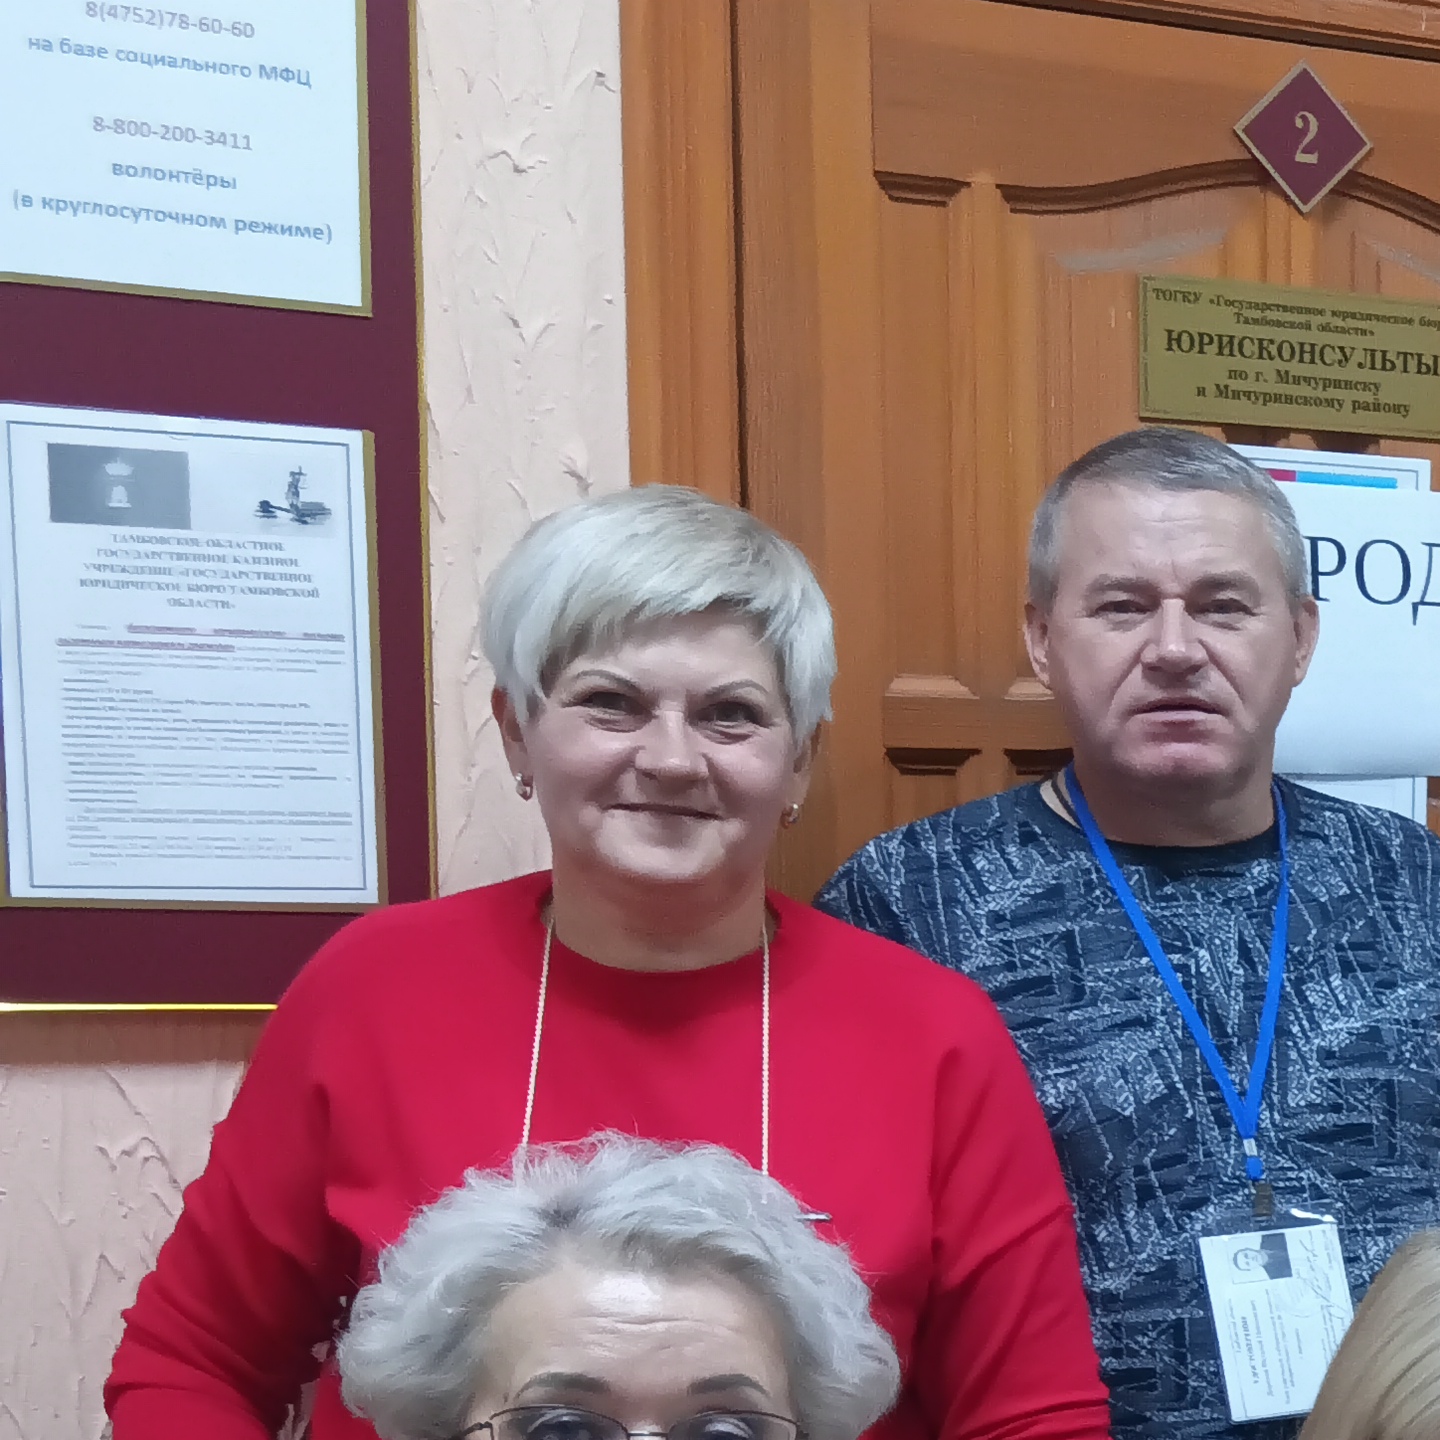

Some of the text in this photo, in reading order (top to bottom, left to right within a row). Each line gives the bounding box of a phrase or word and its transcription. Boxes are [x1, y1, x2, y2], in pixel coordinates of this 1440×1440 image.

[85, 1, 255, 39] 8(4752)78-60-60
[28, 36, 312, 90] на базе социального МФЦ
[93, 116, 252, 151] 8-800-200-3411
[1294, 110, 1319, 163] 2
[112, 162, 237, 191] волонтёры
[13, 189, 333, 244] (в круглосуточном режиме)
[1152, 288, 1203, 304] ТОГКУ
[1209, 294, 1327, 317] «Государственное
[1234, 312, 1374, 337] Тамбовской области»
[1164, 328, 1440, 376] ЮРИСКОНСУЛЬТЫ
[1228, 368, 1381, 395] по г. Мичуринску
[1196, 383, 1410, 419] и Мичуринскому району
